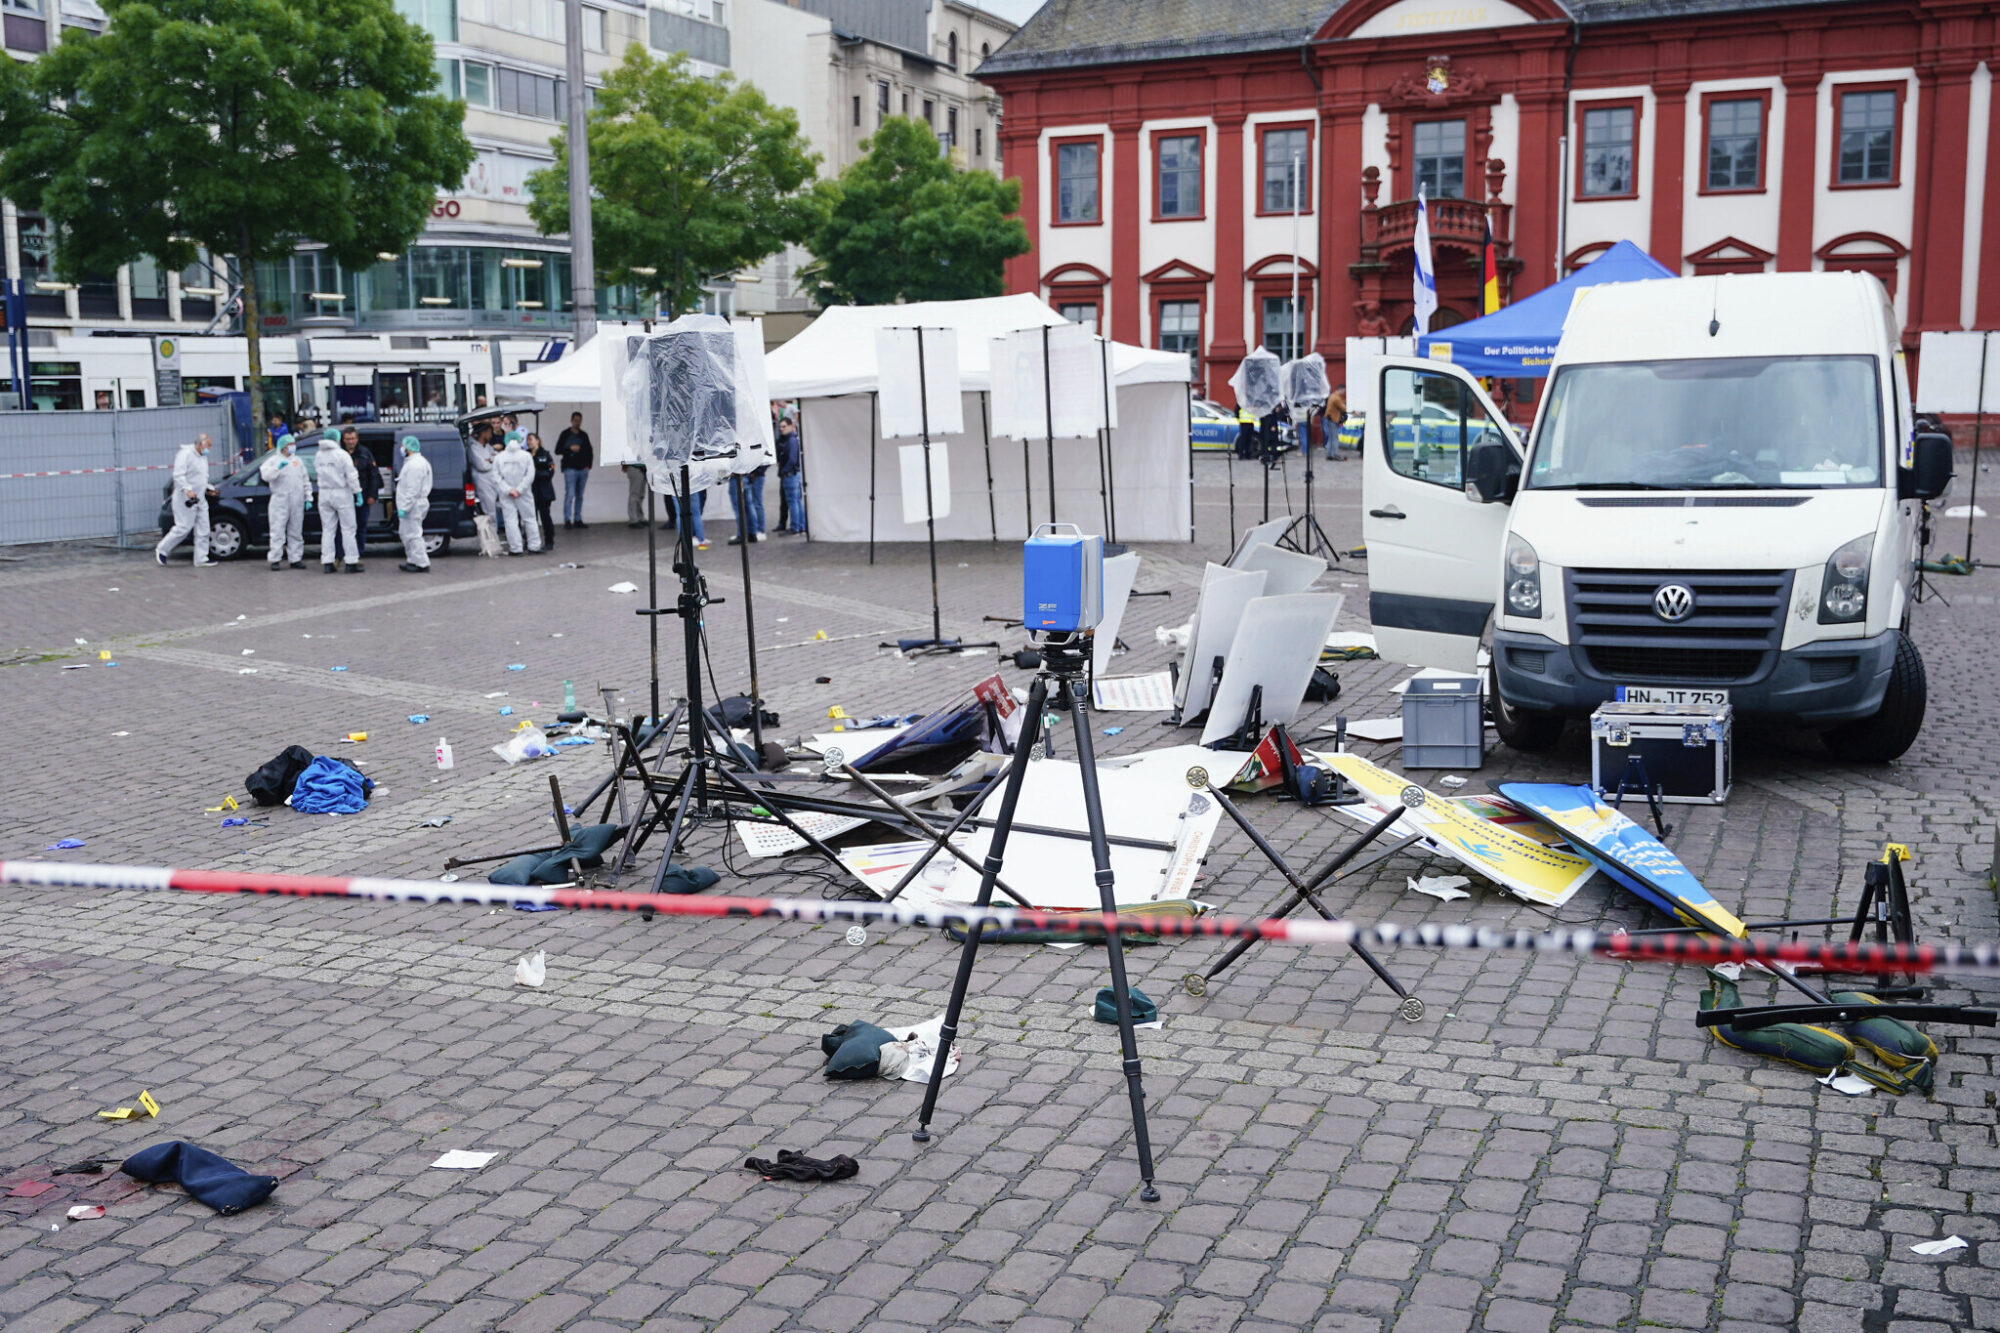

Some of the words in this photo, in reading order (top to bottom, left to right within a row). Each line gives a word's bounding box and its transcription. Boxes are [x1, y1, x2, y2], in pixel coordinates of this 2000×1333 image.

[1484, 346, 1500, 355] Der
[1502, 345, 1545, 355] Politische
[1654, 583, 1693, 621] VW
[1627, 690, 1651, 703] HN
[1691, 692, 1725, 704] 752
